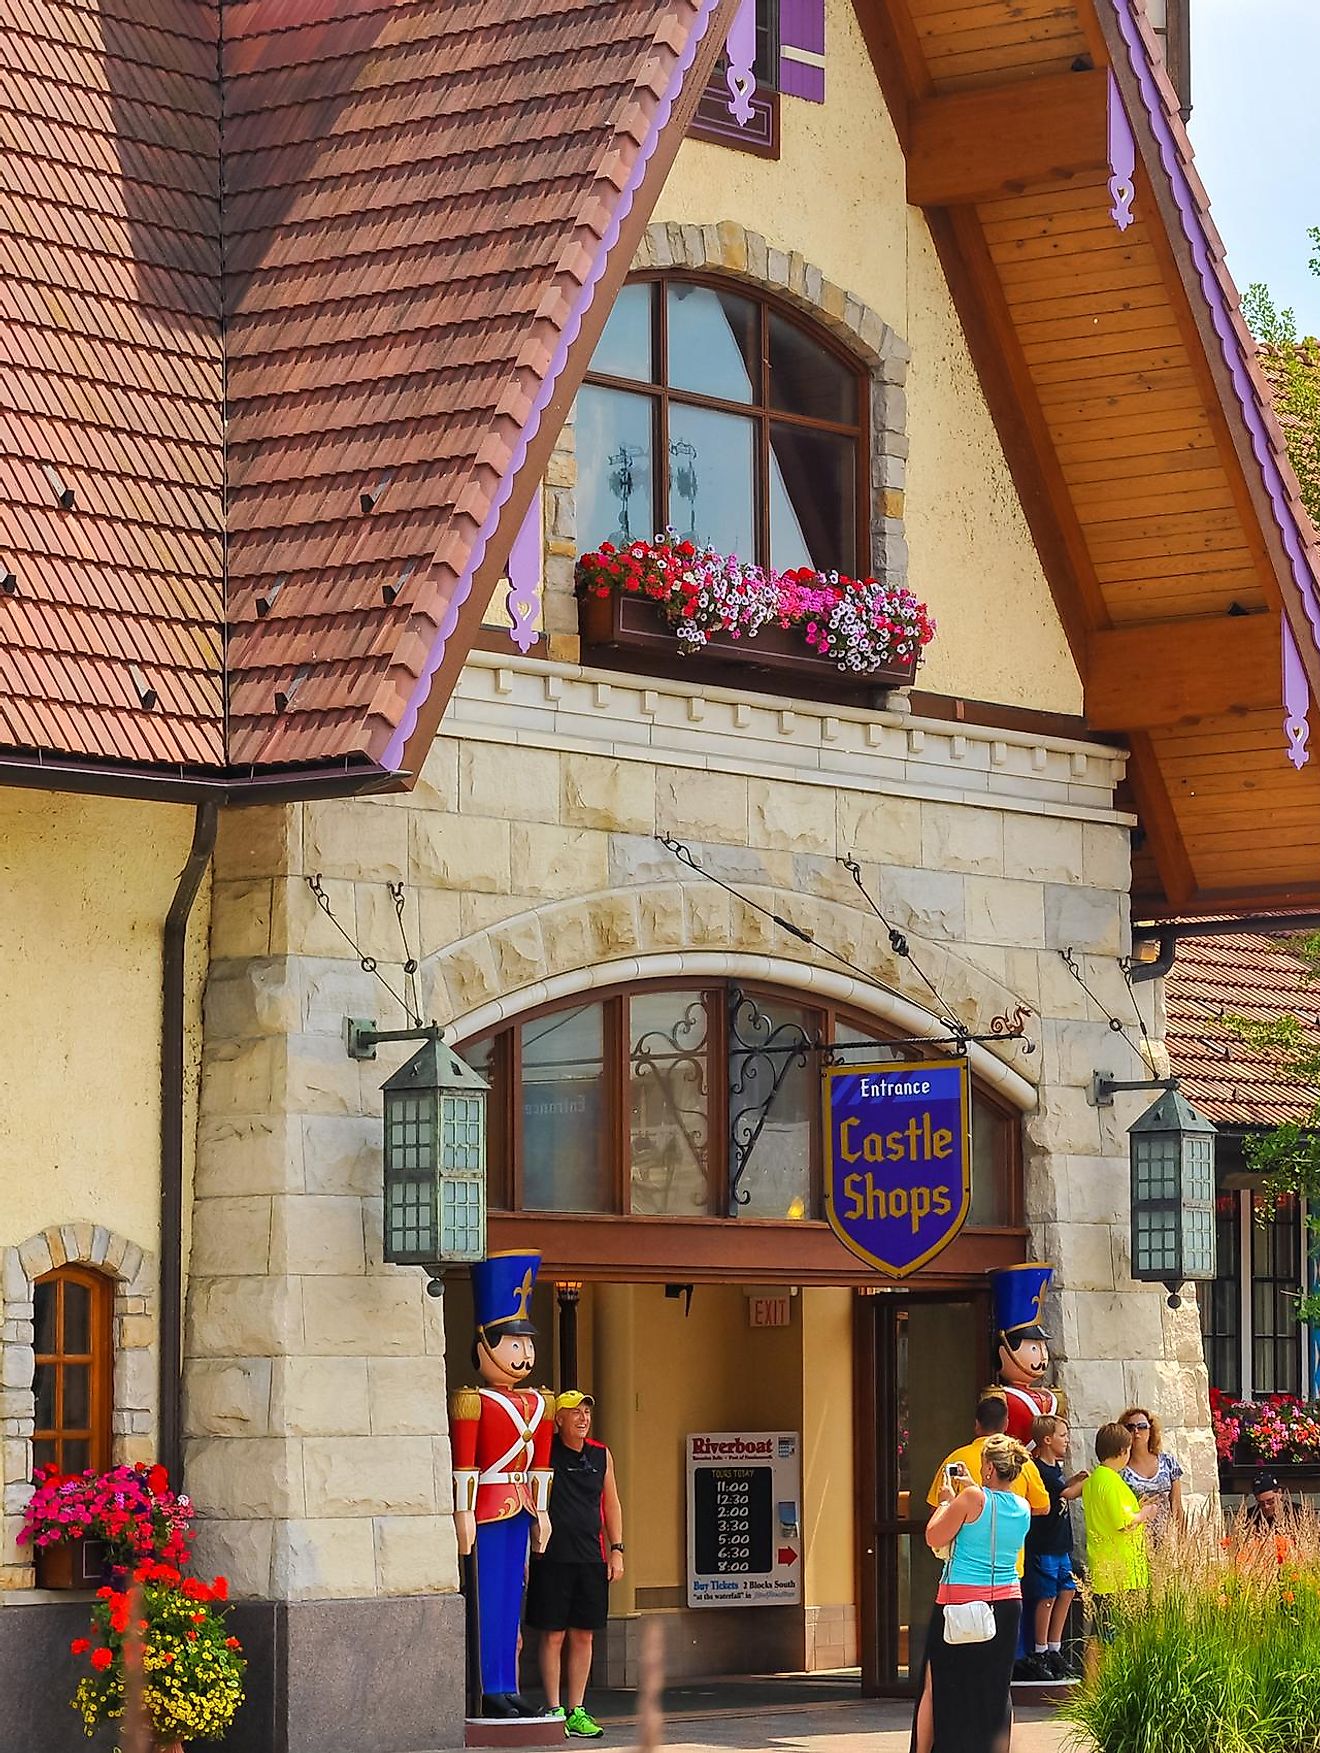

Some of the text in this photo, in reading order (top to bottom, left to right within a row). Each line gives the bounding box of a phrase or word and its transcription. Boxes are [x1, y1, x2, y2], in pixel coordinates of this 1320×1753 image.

[860, 1078, 931, 1098] Entrance
[840, 1112, 953, 1164] Castle
[843, 1171, 952, 1235] Shops
[755, 1299, 786, 1325] EXIT
[692, 1437, 774, 1454] Riverboat
[717, 1481, 749, 1492] 11:00
[717, 1494, 749, 1505] 12:30
[718, 1506, 749, 1518] 2:00
[718, 1520, 749, 1531] 3:30
[718, 1533, 750, 1545] 5:00
[718, 1547, 750, 1558] 6:30
[718, 1561, 749, 1571] 8:00
[693, 1580, 709, 1592] Buy
[710, 1580, 739, 1590] Tickets
[749, 1580, 773, 1589] Blocks
[774, 1579, 796, 1589] South
